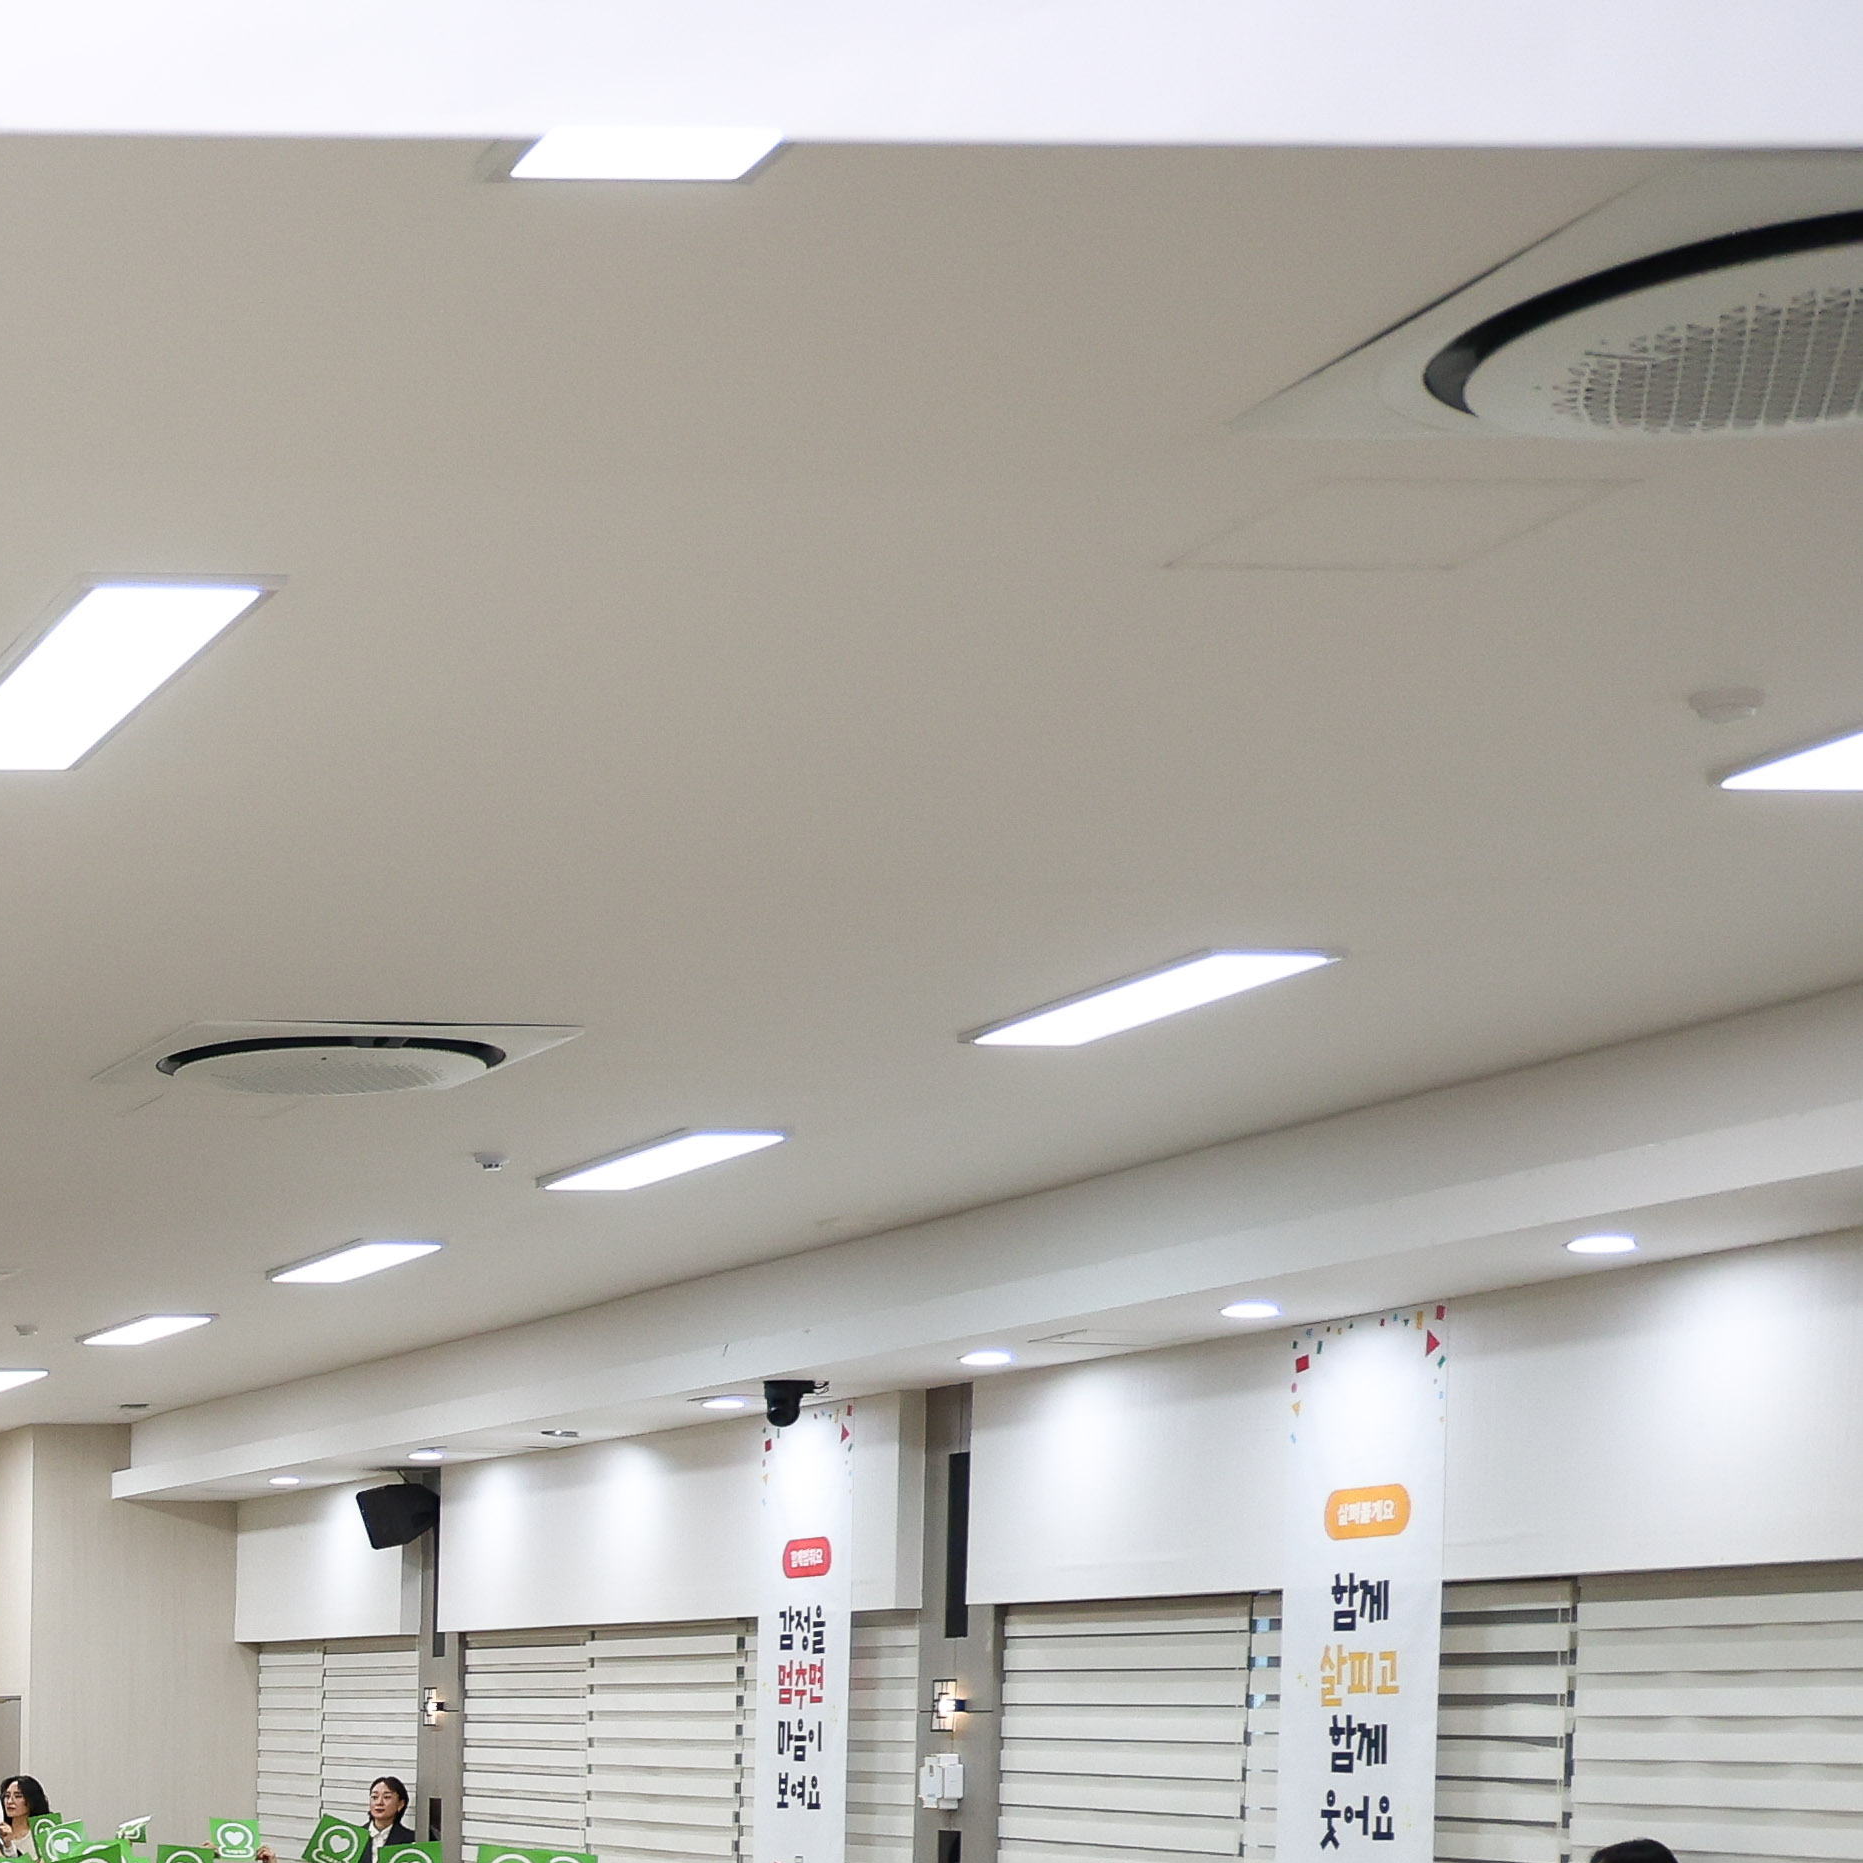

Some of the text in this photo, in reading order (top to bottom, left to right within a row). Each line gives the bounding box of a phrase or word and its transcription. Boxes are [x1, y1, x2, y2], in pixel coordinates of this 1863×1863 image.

[1330, 1572, 1390, 1631] 함께
[779, 1605, 826, 1655] 감정을
[778, 1658, 825, 1710] 멈추면
[1320, 1644, 1400, 1707] 살피고
[777, 1717, 823, 1762] 마음이
[1329, 1714, 1388, 1774] 함께
[776, 1772, 822, 1810] 보여요
[1320, 1788, 1395, 1850] 웃어요
